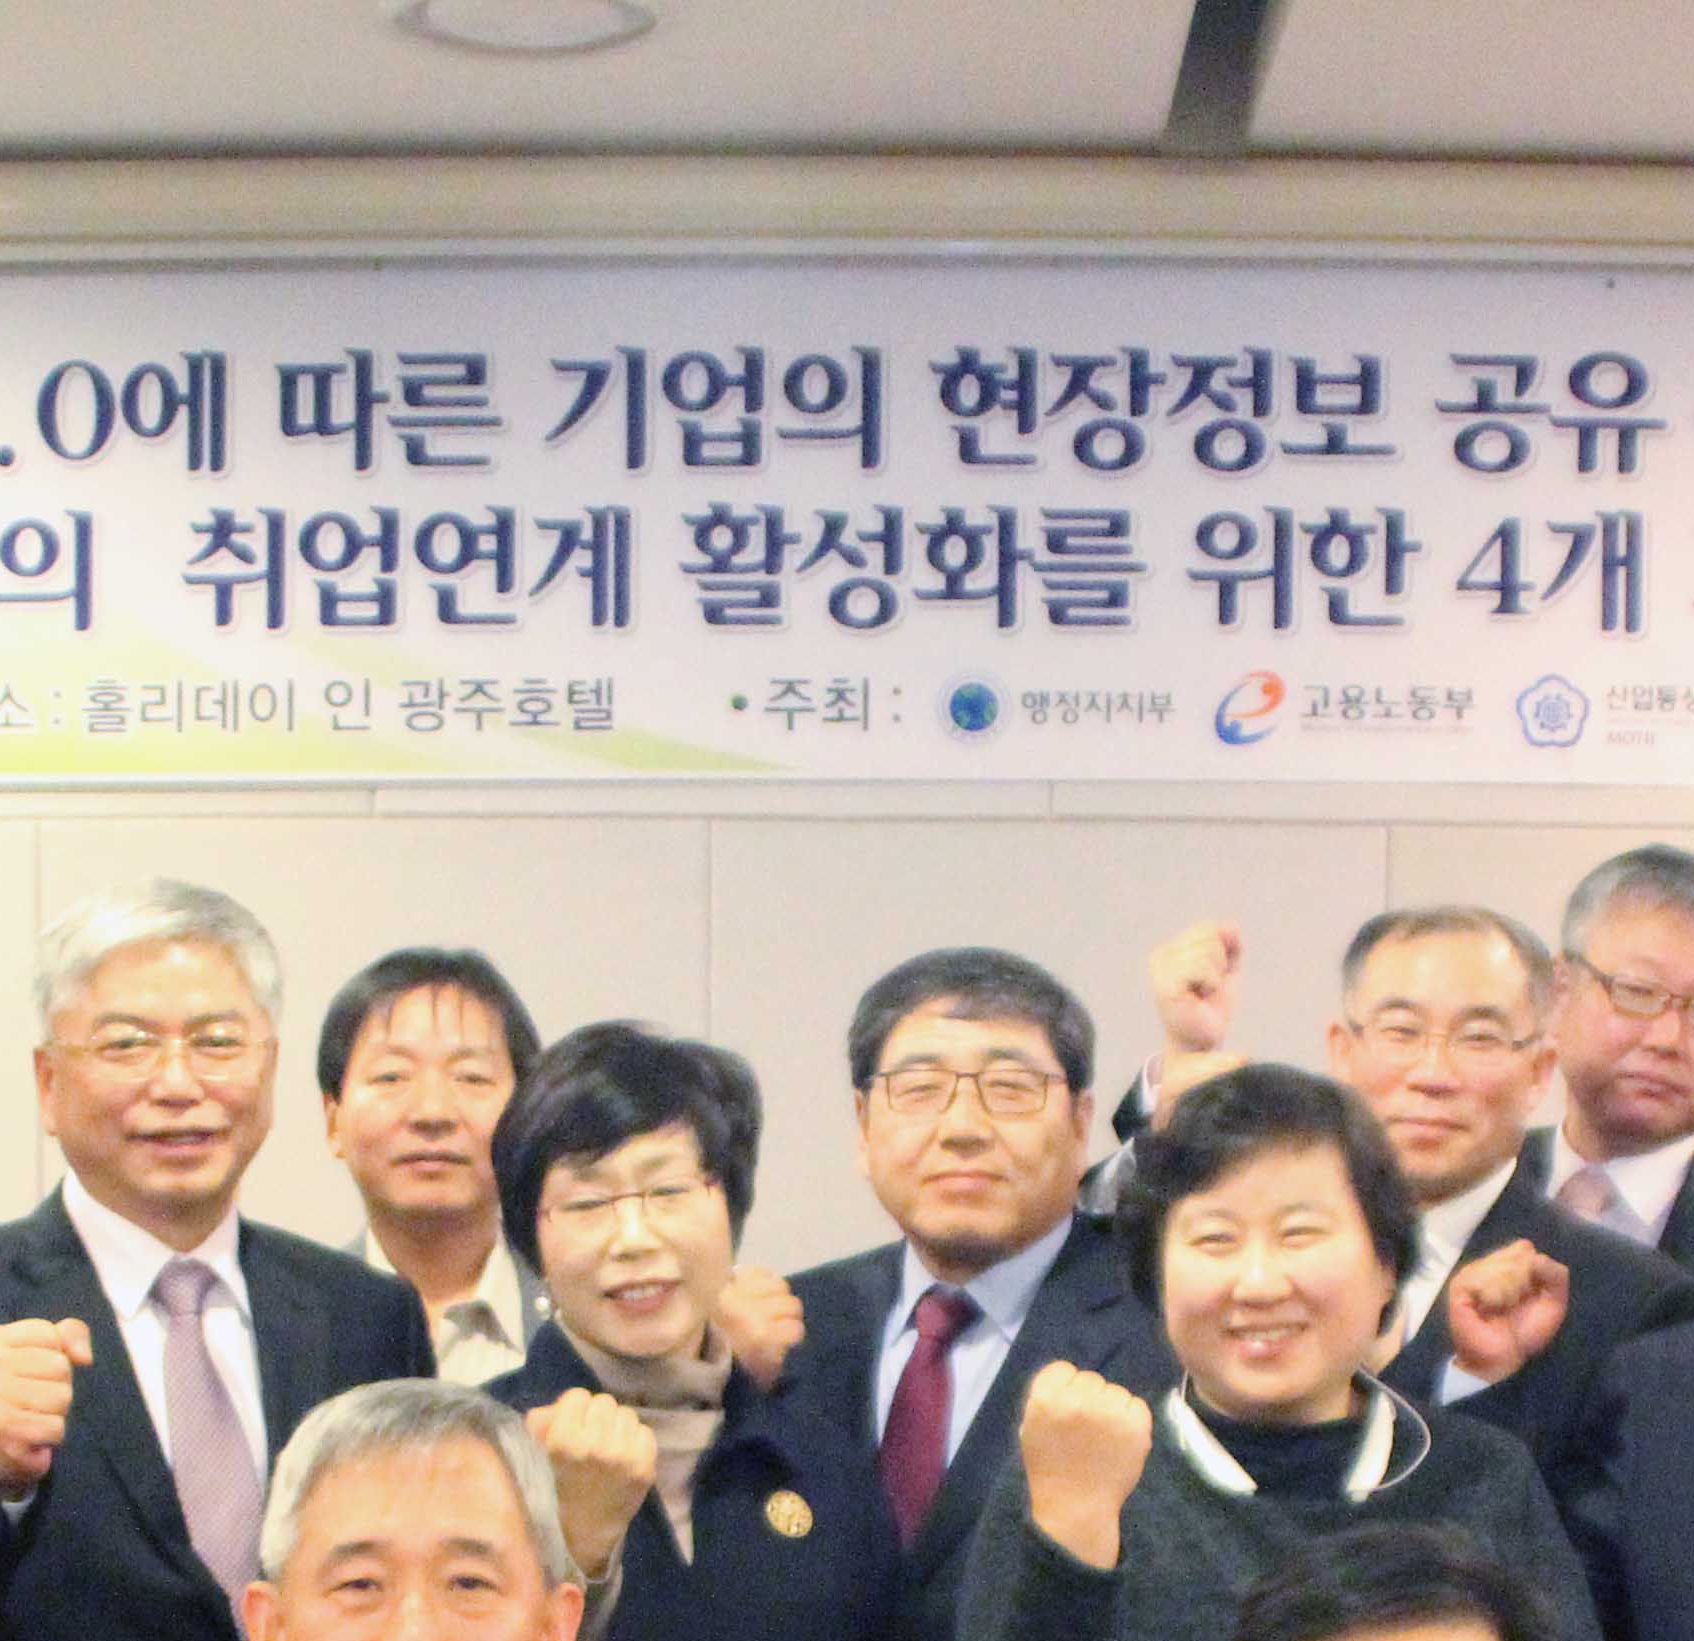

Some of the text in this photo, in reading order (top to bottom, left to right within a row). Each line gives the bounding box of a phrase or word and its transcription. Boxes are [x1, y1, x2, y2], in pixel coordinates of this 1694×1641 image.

[275, 346, 505, 472] 따른
[545, 344, 884, 471] 기업의
[928, 345, 1398, 473] 현장정보
[181, 503, 632, 630] 취업연계
[679, 500, 1148, 631] 활성화를
[1186, 503, 1422, 630] 위한
[1455, 508, 1644, 635] 4개
[80, 677, 296, 735] 홀리데이
[323, 676, 373, 734] 인
[398, 675, 616, 735] 광주호텔
[1300, 683, 1476, 723] 고용노동부
